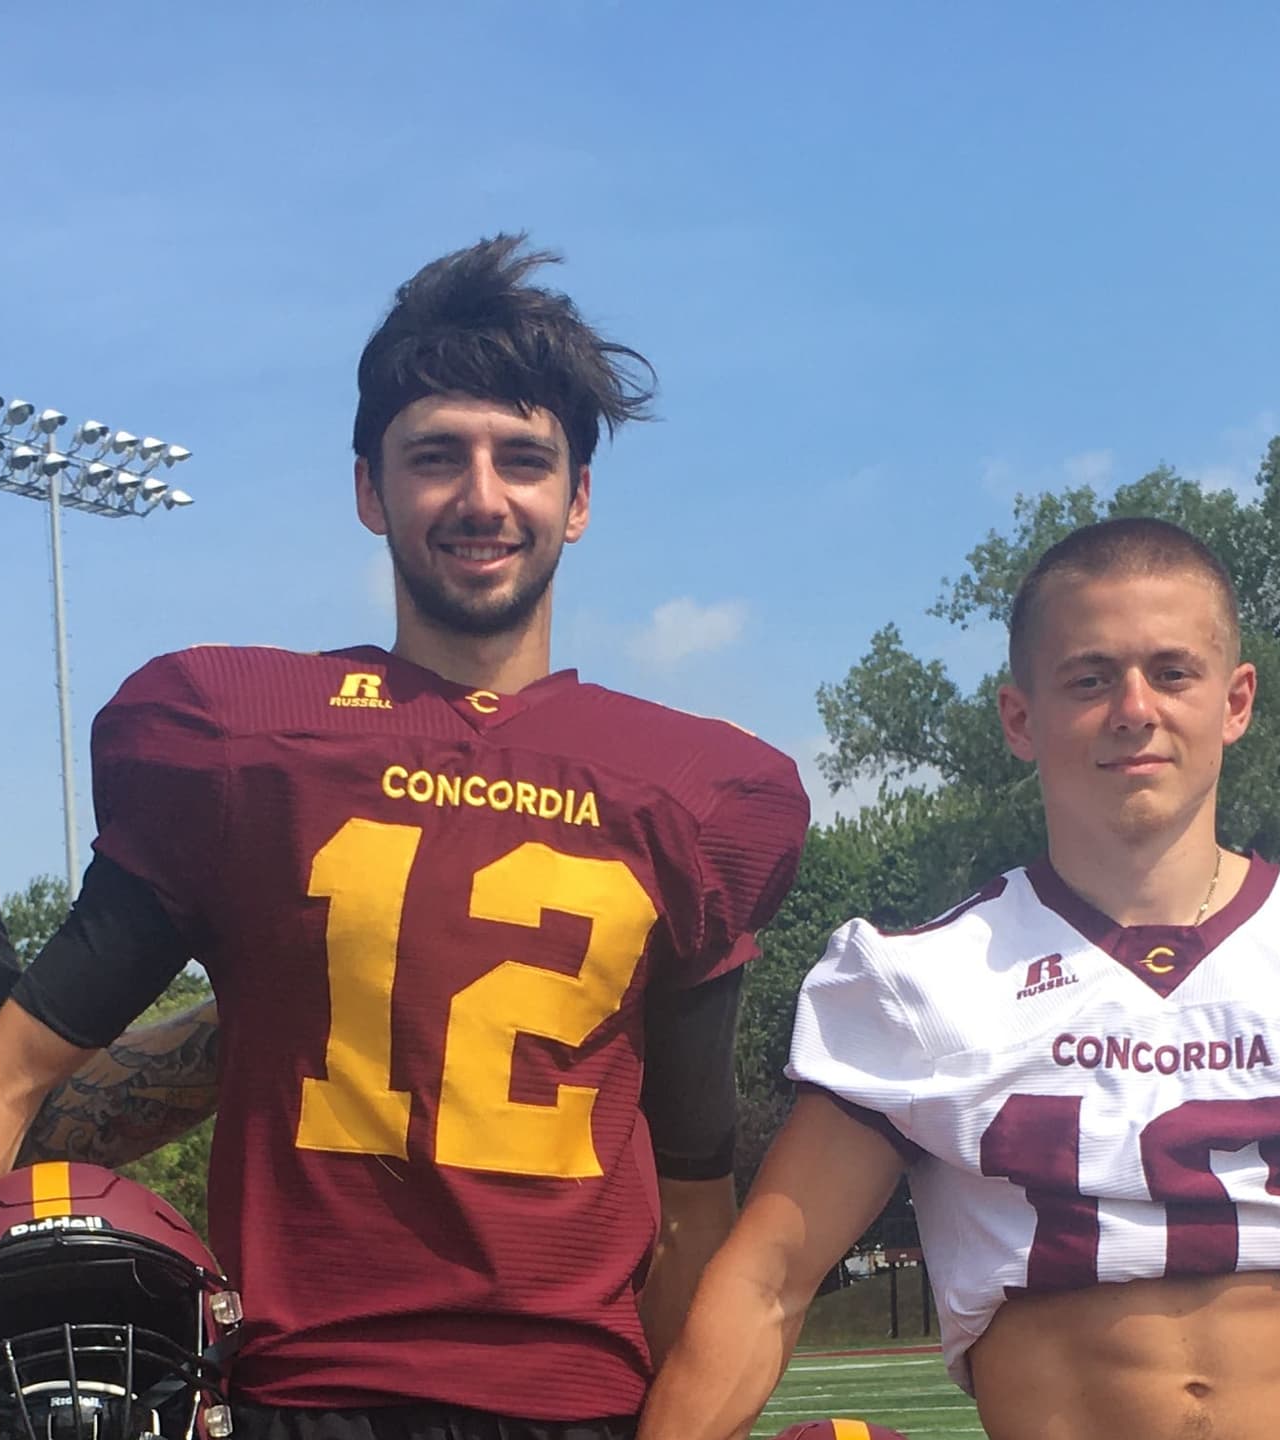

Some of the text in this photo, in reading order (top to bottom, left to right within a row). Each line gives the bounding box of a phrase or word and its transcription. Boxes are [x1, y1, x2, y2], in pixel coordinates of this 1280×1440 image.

[329, 696, 393, 710] RUSSELL
[381, 765, 601, 828] CONCORDIA
[294, 816, 659, 1180] 12
[1016, 974, 1080, 1000] RUSSELL
[1052, 1033, 1273, 1075] CONCORDIA
